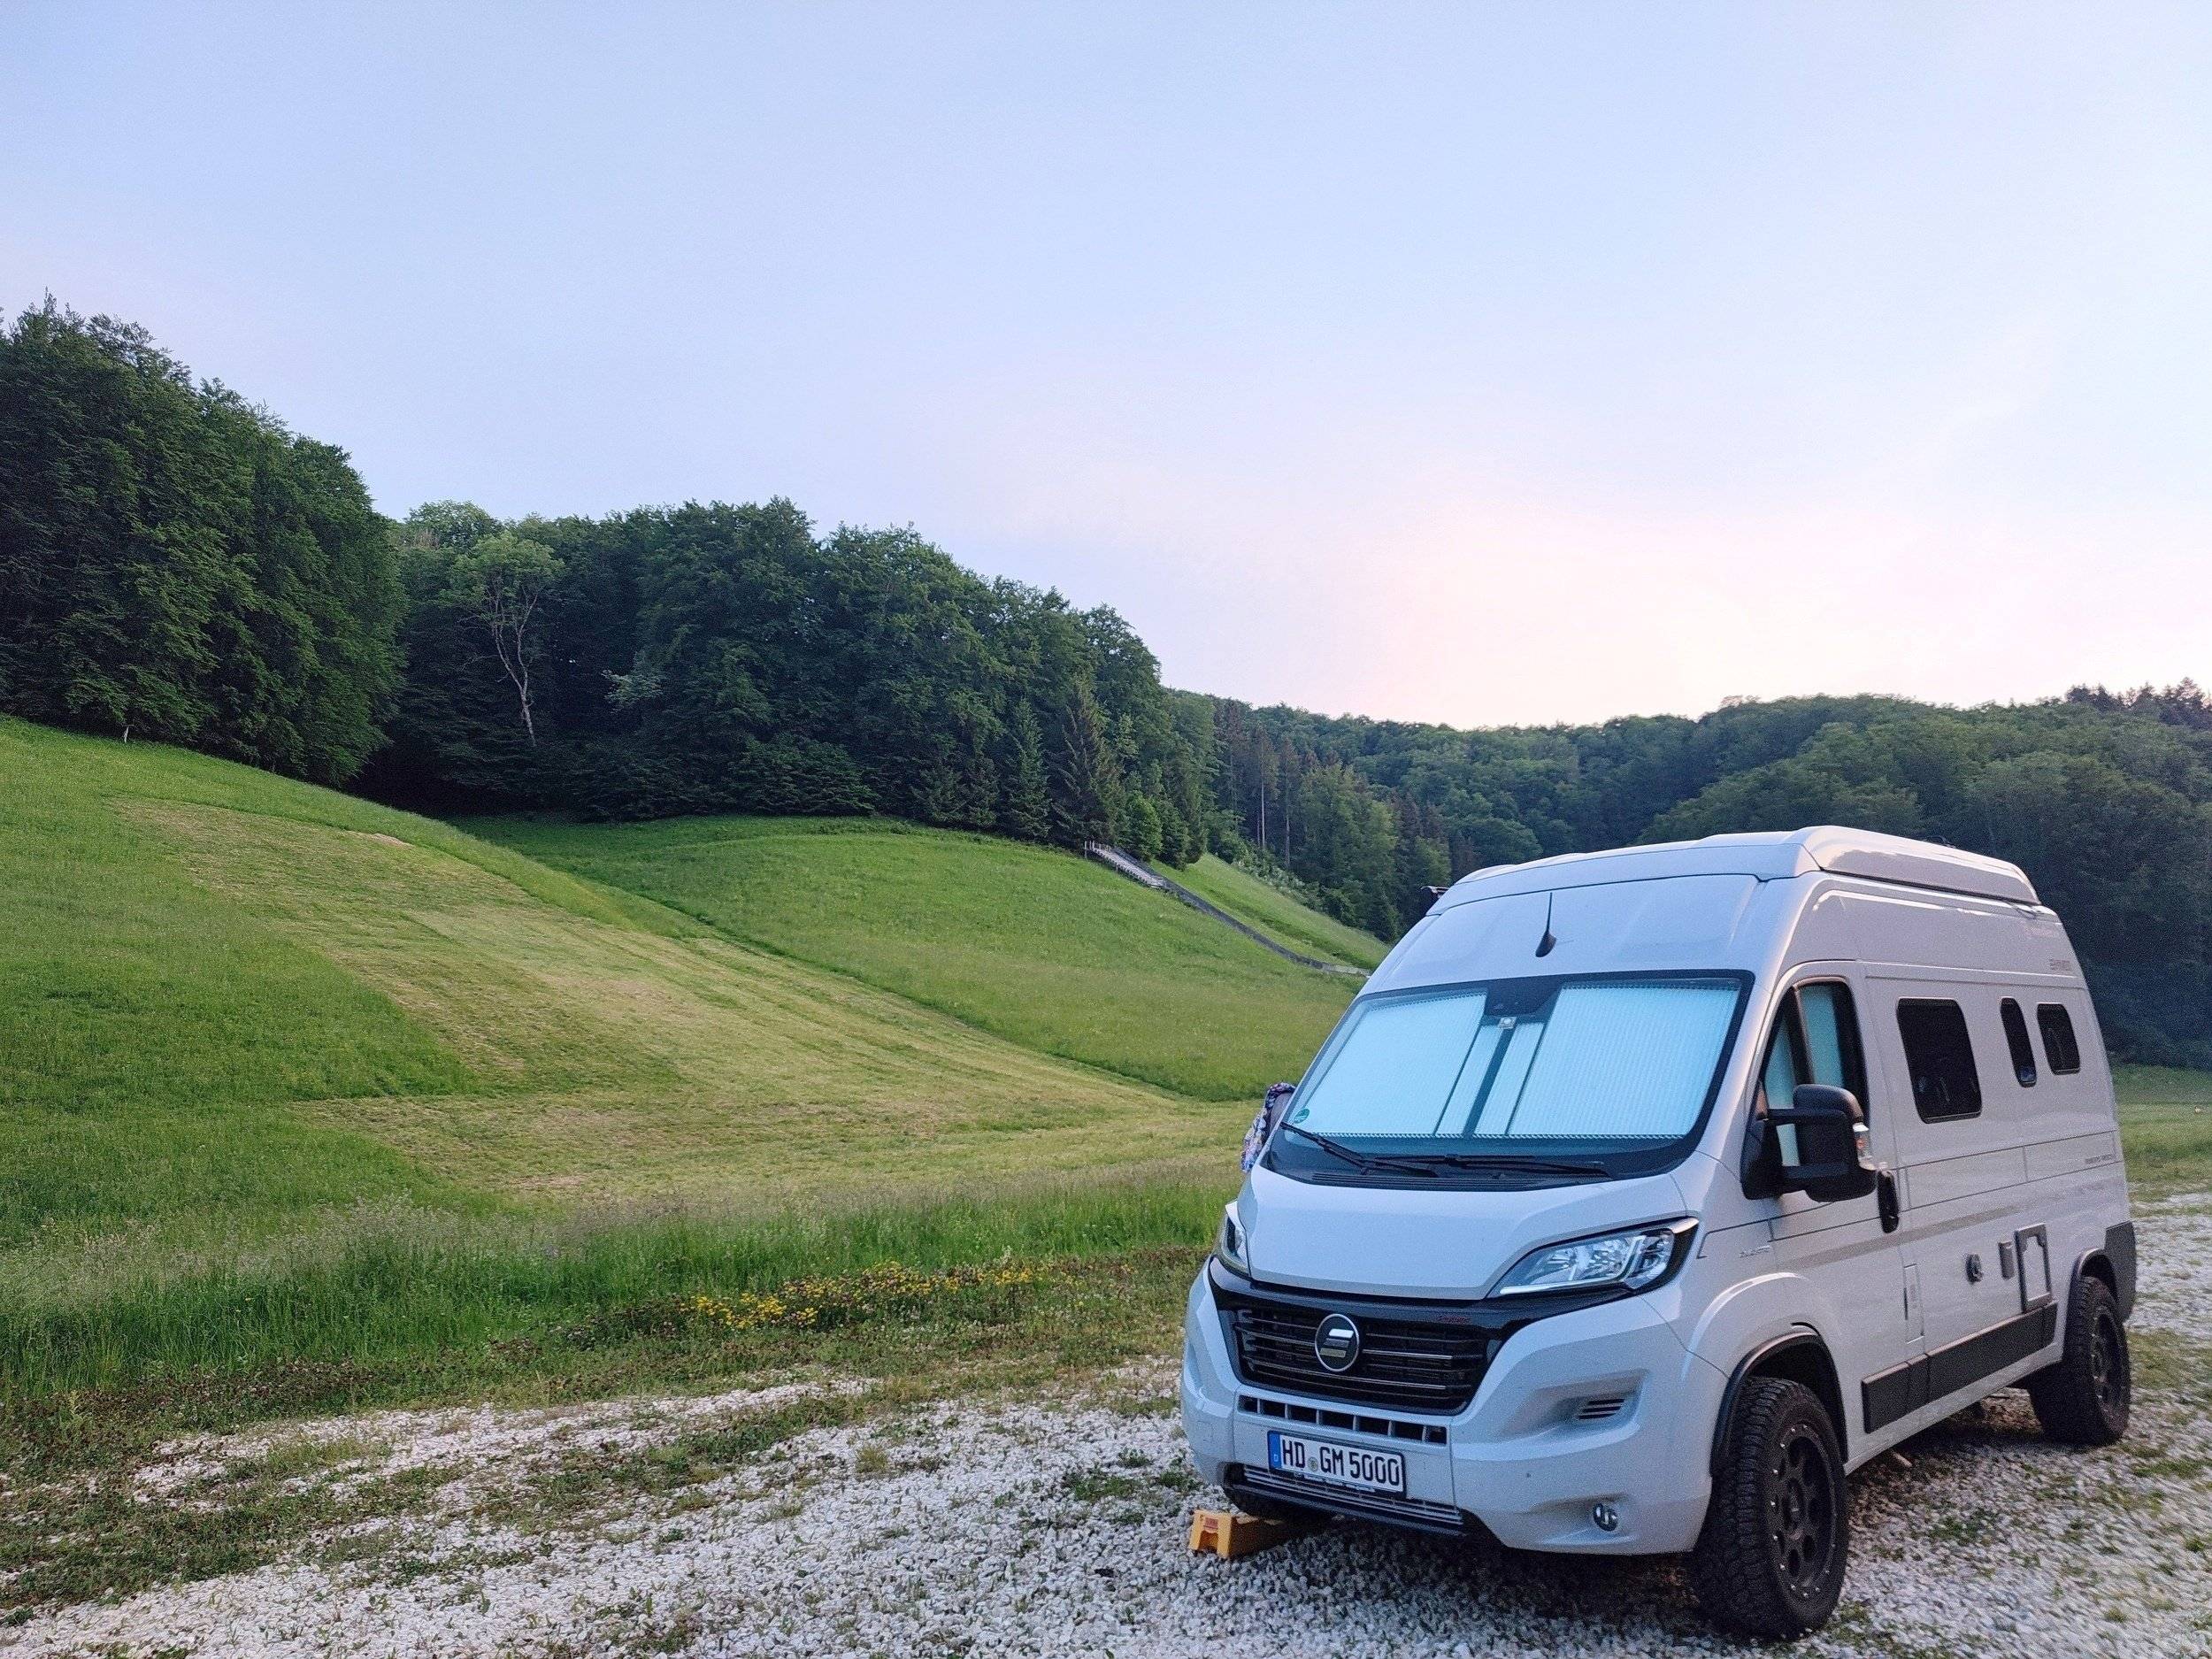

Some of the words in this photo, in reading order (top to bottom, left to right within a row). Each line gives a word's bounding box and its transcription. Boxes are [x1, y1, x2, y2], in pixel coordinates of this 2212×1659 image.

[1282, 1439, 1306, 1469] HD
[1319, 1446, 1345, 1477] GM
[1348, 1451, 1401, 1486] 5000
